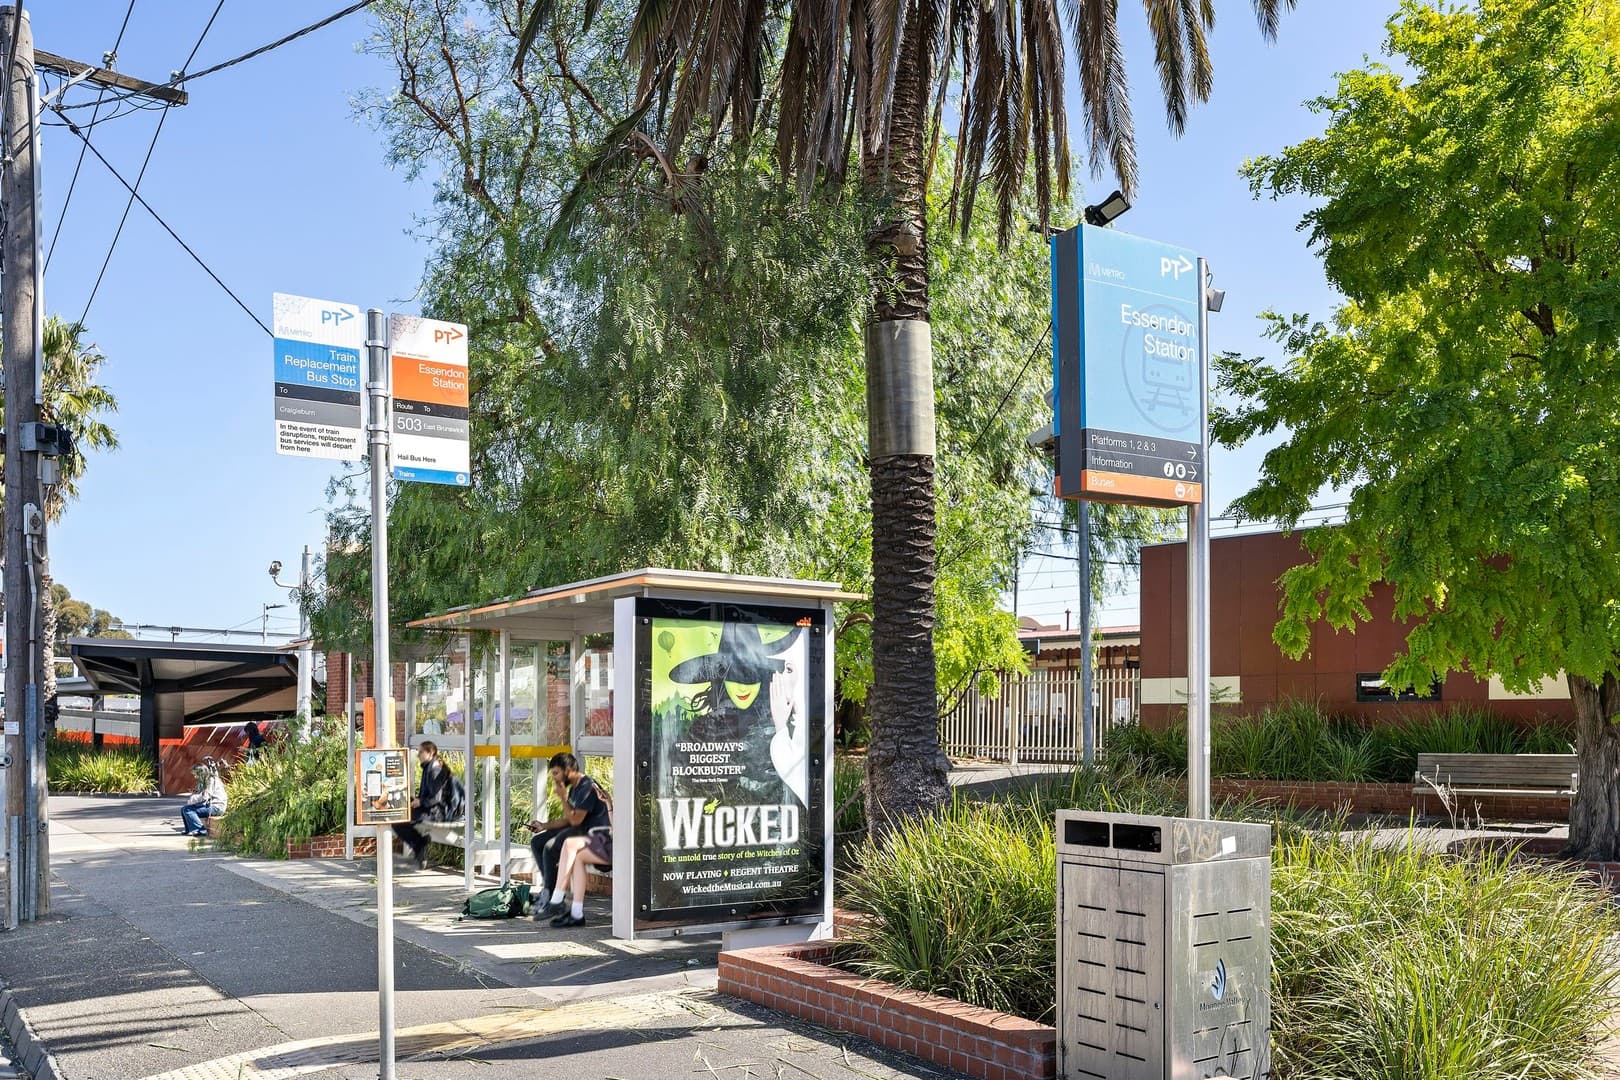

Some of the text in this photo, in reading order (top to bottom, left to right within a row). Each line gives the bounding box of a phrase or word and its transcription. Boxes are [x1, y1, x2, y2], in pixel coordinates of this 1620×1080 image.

[1121, 304, 1196, 336] Essendon
[1144, 334, 1196, 362] Station
[329, 350, 356, 362] Train
[284, 355, 356, 374] Replacement
[418, 364, 464, 378] Essendon
[306, 371, 356, 388] Bus Stop
[432, 377, 464, 390] Station
[397, 417, 422, 432] 503
[318, 435, 356, 444] replacement
[1091, 434, 1127, 448] Platforms
[1137, 441, 1142, 450] 2
[1144, 442, 1150, 451] &
[1150, 442, 1156, 452] 3
[1091, 456, 1133, 470] Information
[690, 754, 730, 764] BIGGEST
[672, 765, 746, 776] BLOCKBUSTER”
[678, 853, 700, 862] untold
[702, 852, 716, 860] true
[718, 852, 734, 861] story
[736, 850, 744, 858] of
[744, 850, 755, 858] the
[756, 849, 781, 857] Witches
[663, 864, 800, 881] NOW PLAYING REGENT THEATRE
[682, 880, 782, 894] WickedtheMusical.com.au
